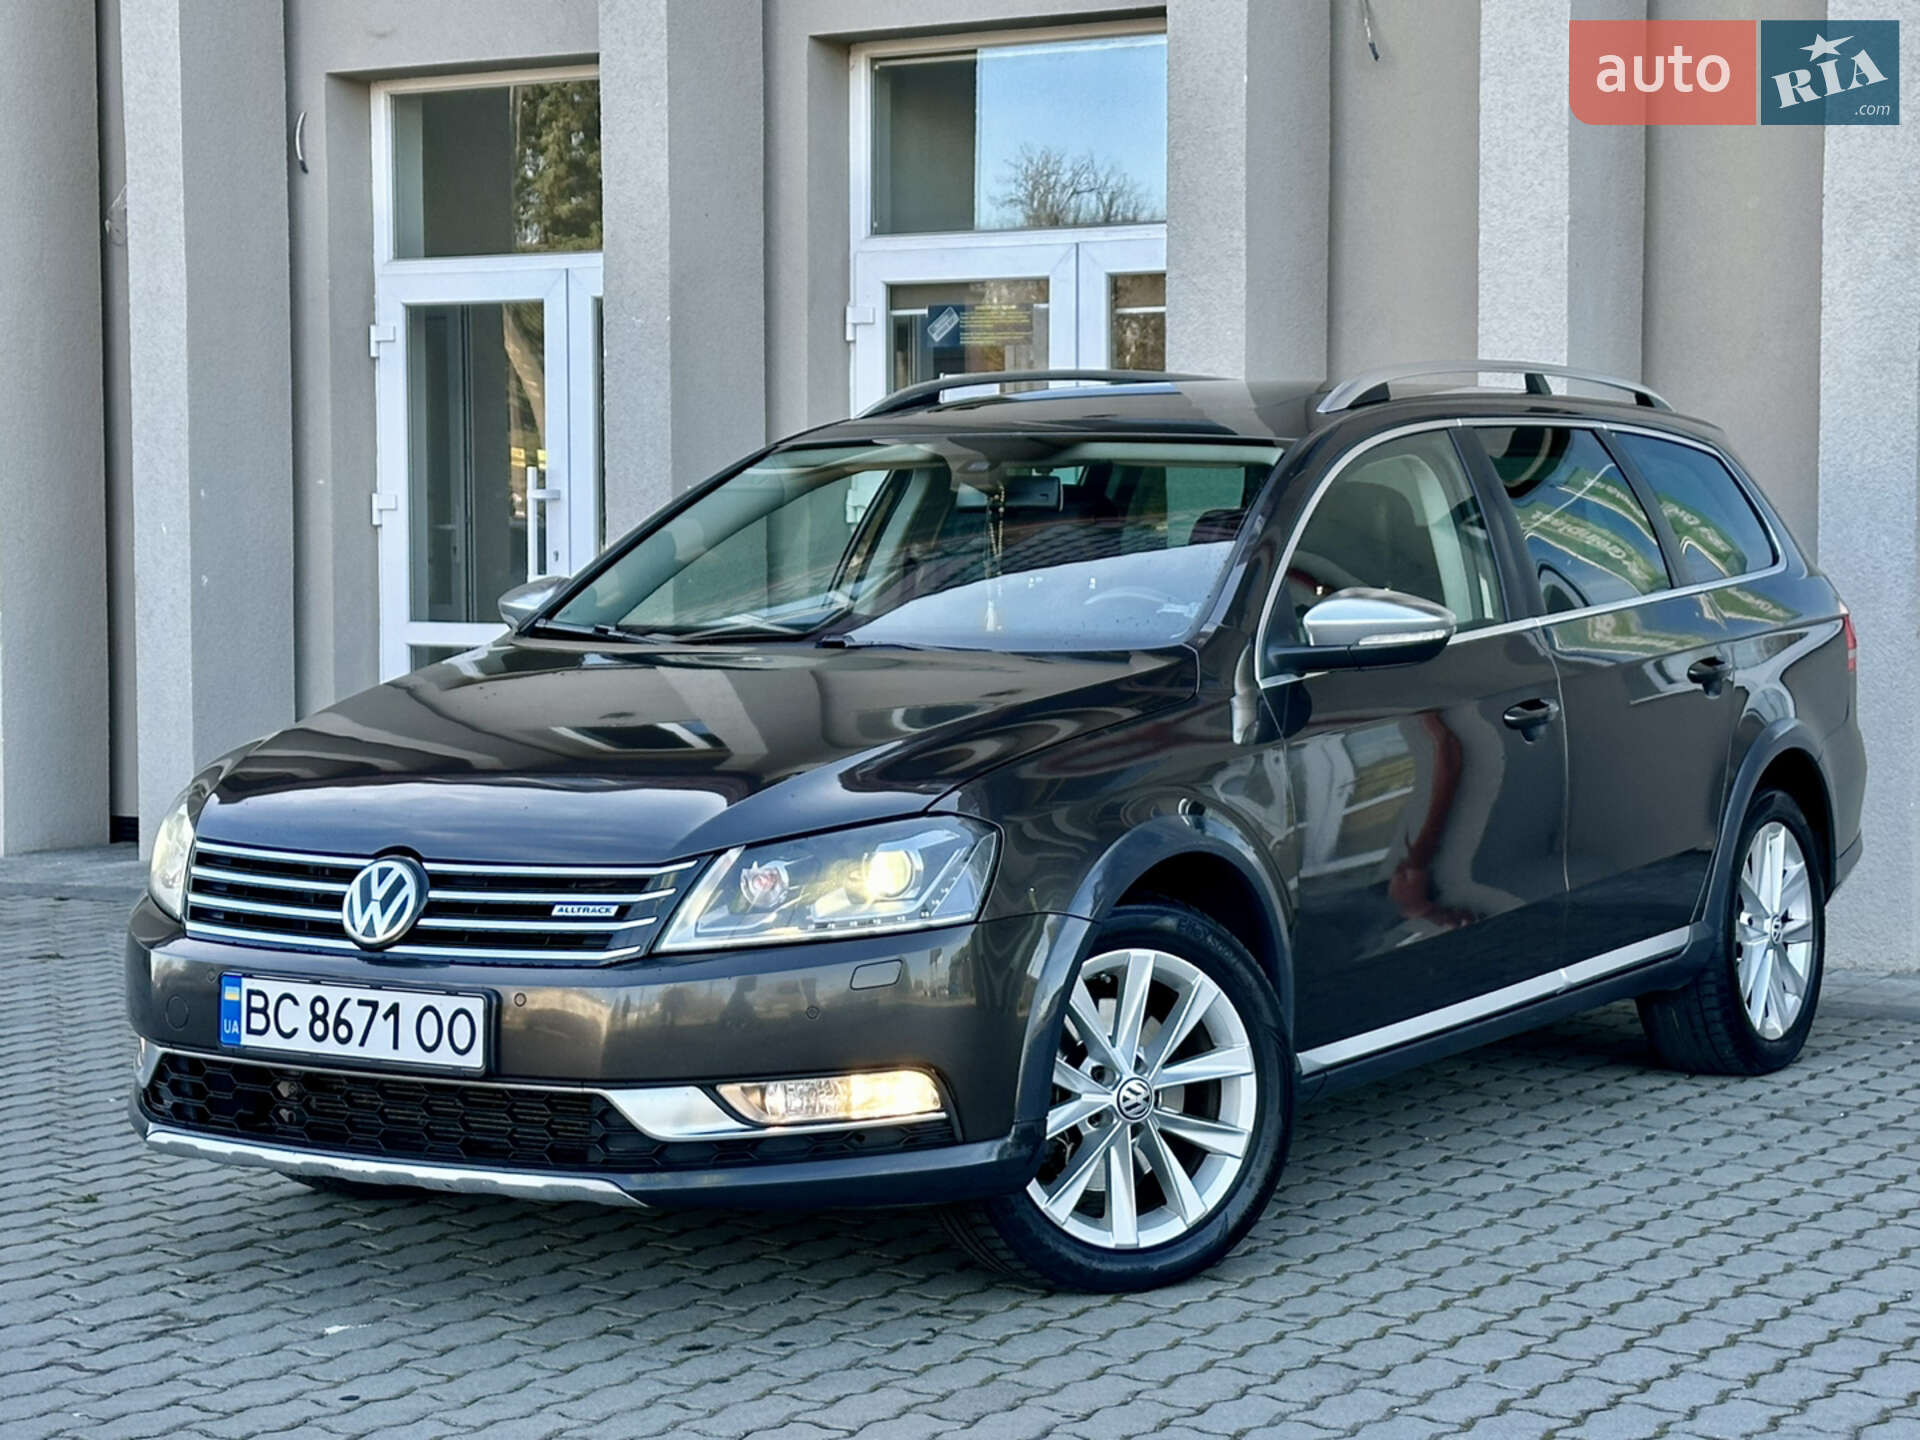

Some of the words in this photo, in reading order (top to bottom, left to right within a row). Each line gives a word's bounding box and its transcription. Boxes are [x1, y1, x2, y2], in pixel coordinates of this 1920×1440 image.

[557, 906, 612, 914] ALLTRACK
[223, 1019, 239, 1035] UA
[246, 988, 299, 1040] BC
[308, 995, 400, 1051] 8671
